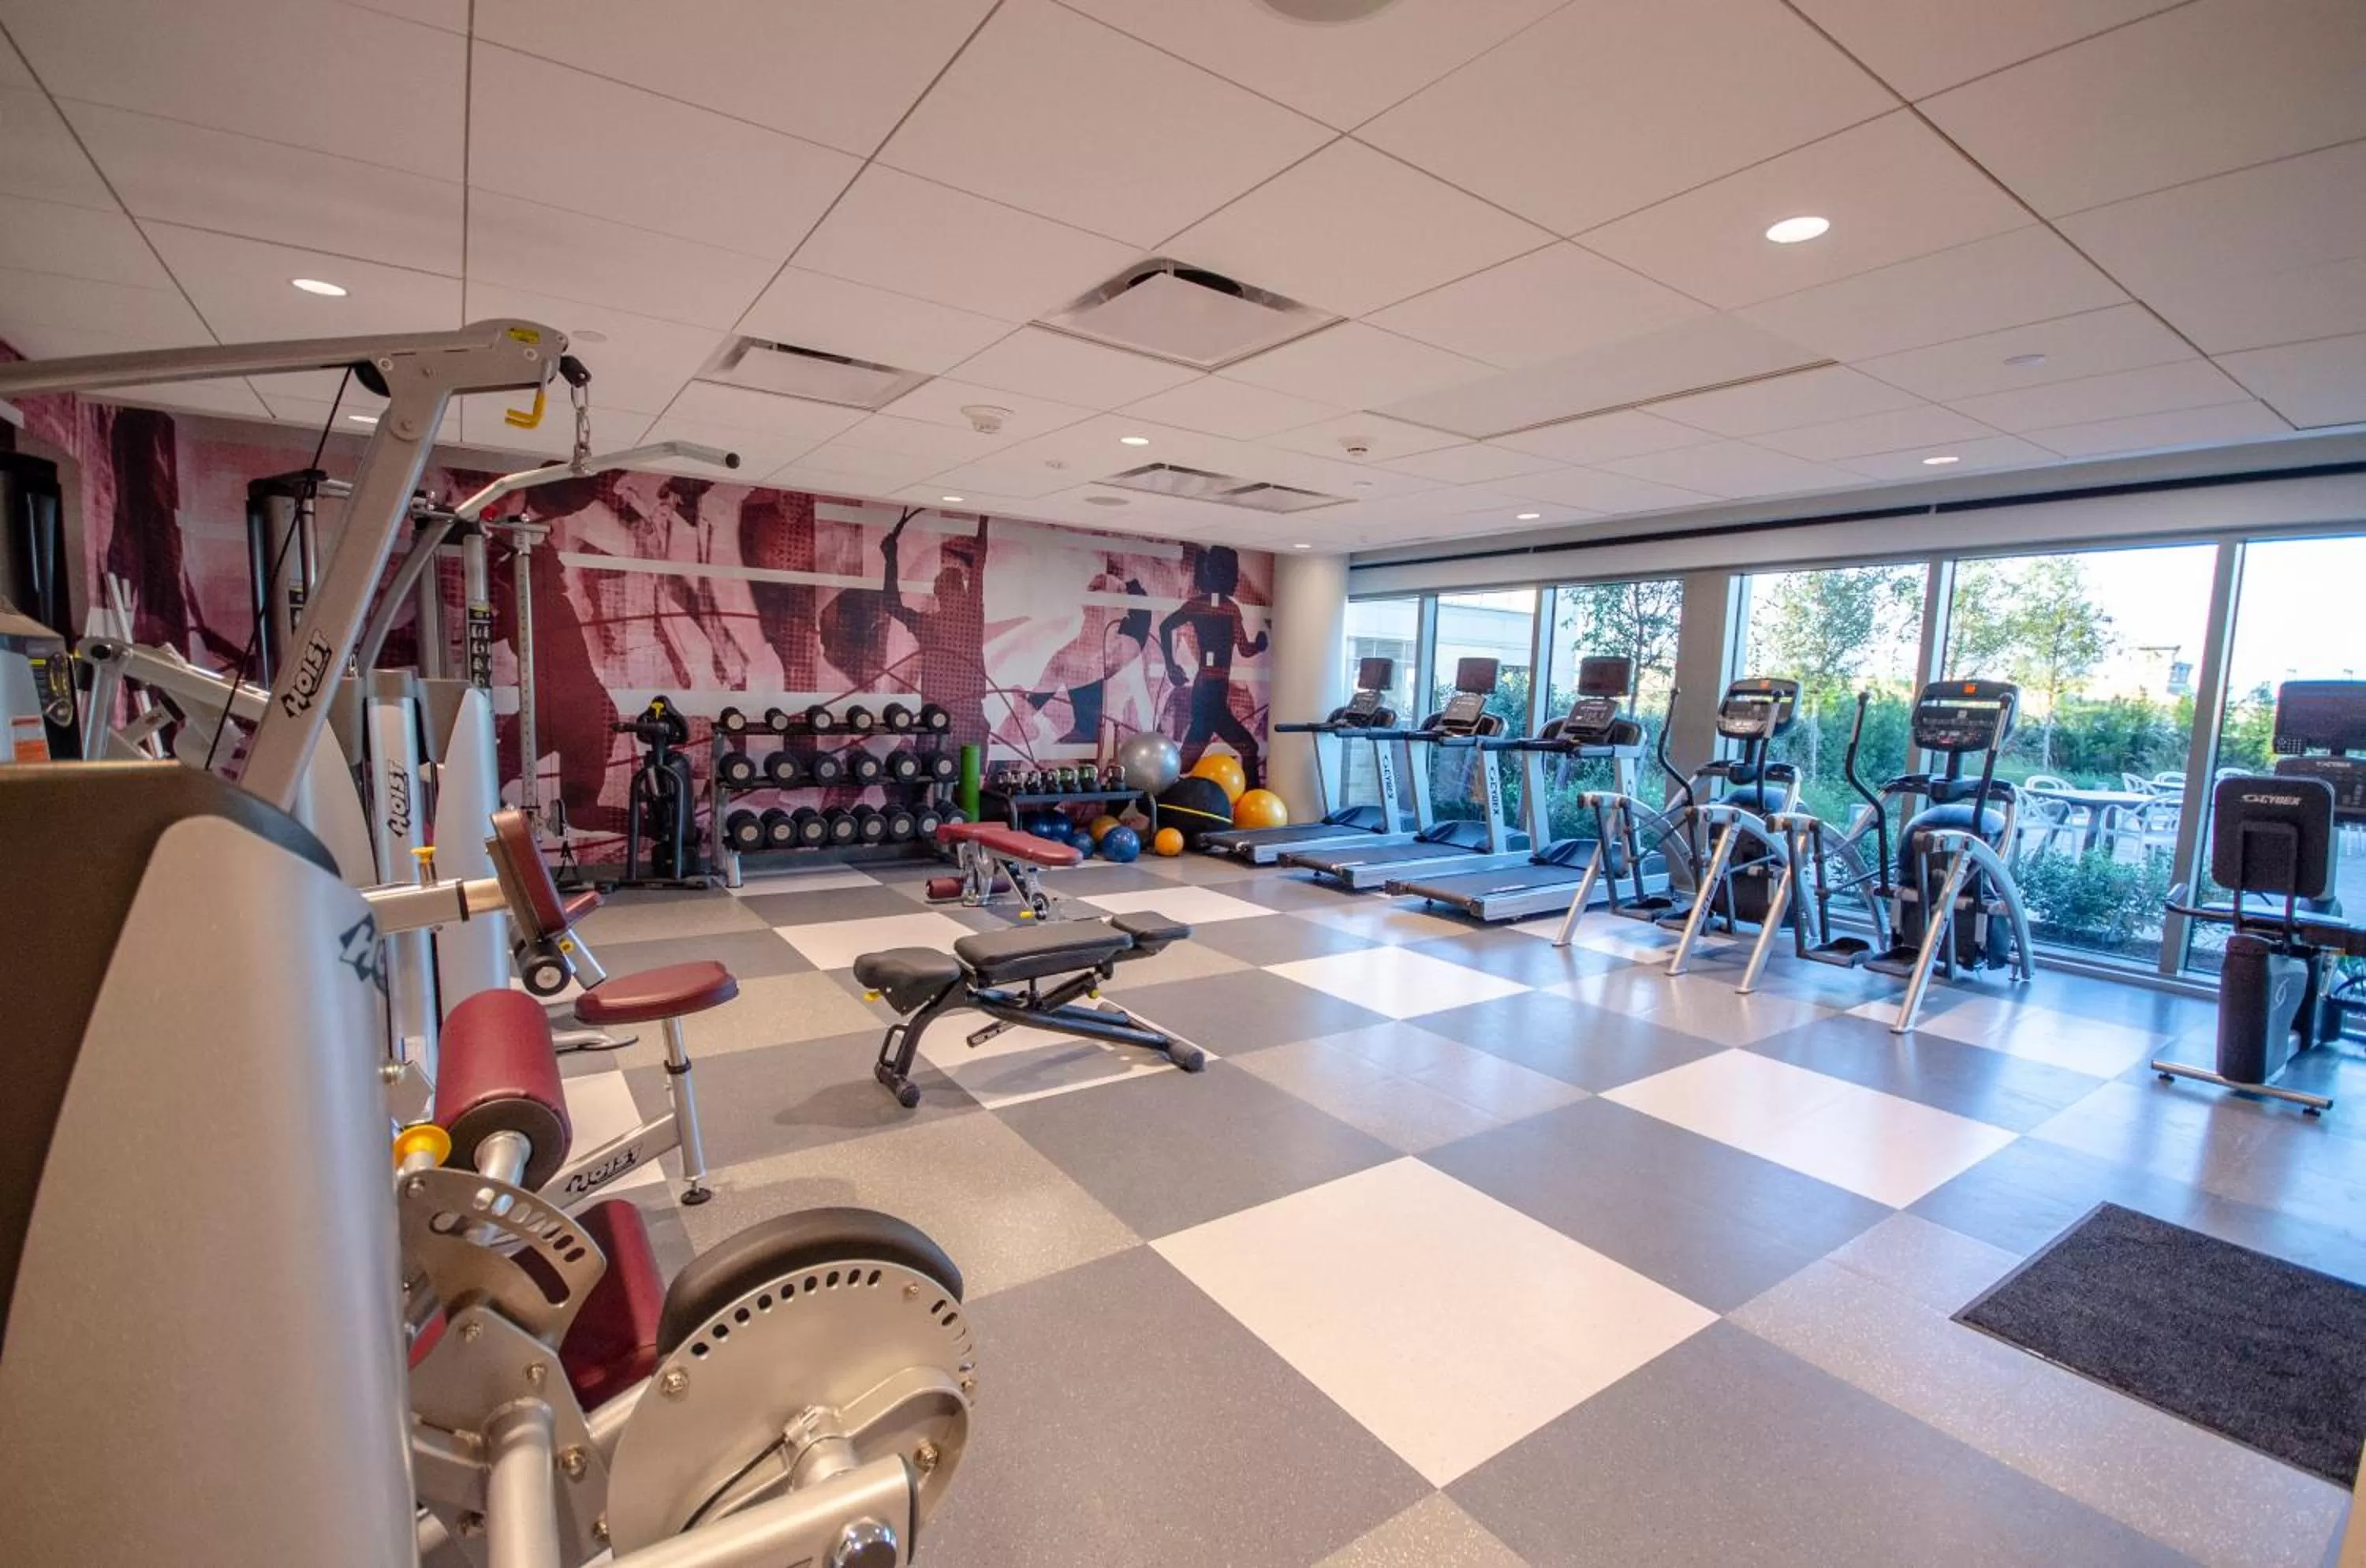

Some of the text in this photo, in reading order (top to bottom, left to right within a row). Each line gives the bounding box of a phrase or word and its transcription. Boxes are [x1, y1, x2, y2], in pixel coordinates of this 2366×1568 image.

[281, 631, 332, 719] HOIST
[387, 759, 411, 837] HOIST
[2258, 794, 2302, 806] CYBEX
